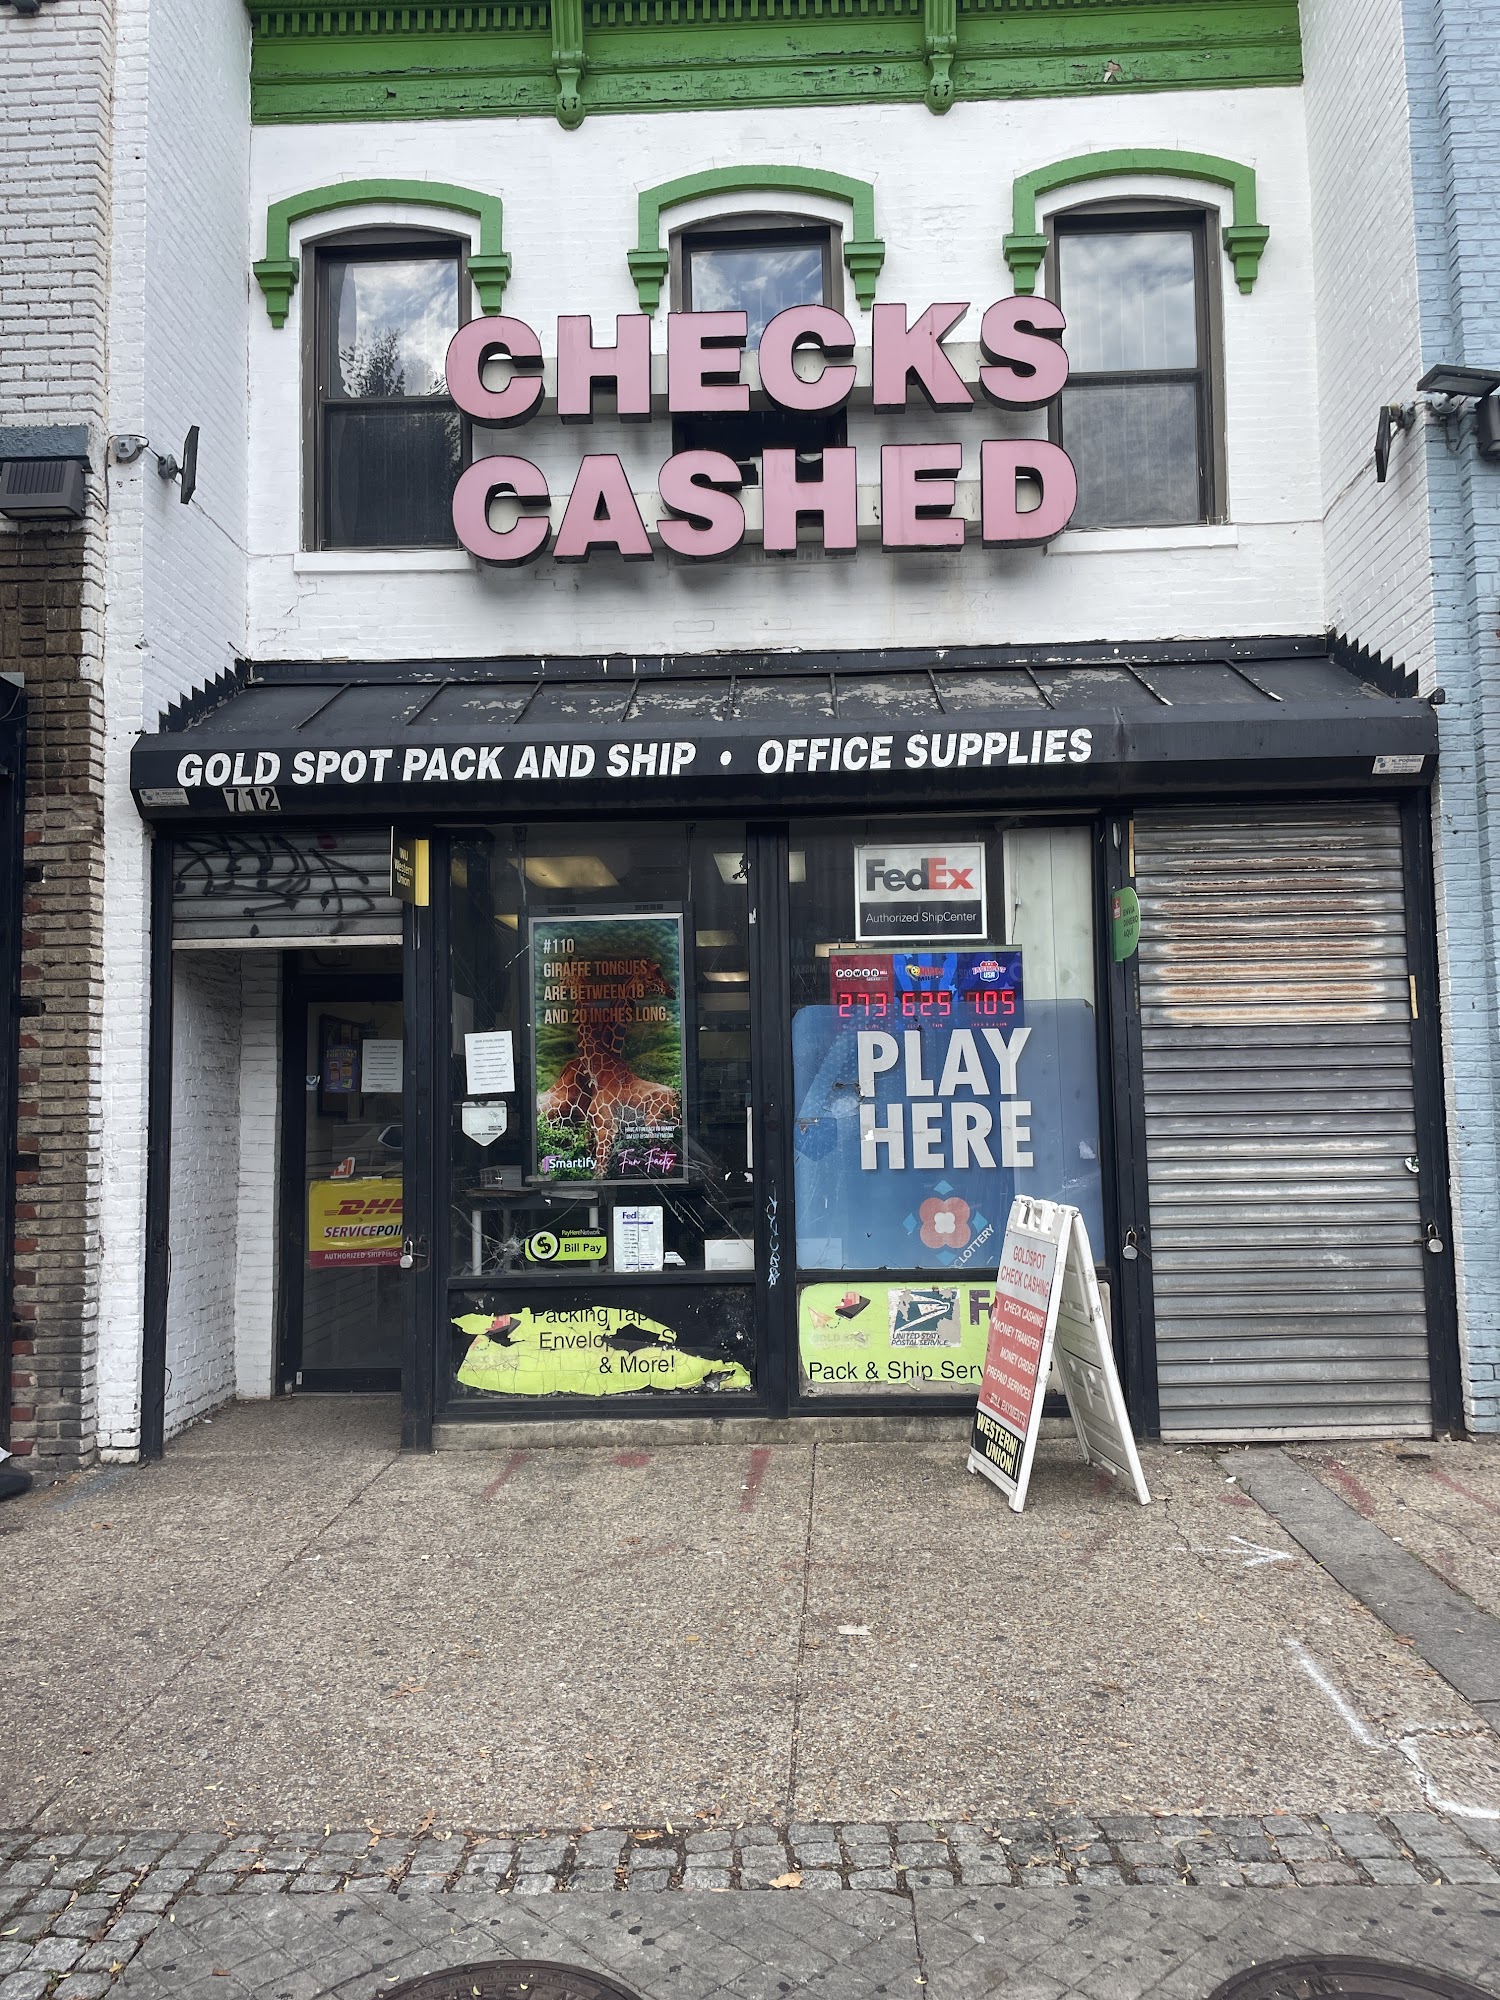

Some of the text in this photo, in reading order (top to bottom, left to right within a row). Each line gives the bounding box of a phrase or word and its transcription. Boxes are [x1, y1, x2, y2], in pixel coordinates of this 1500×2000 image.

[445, 295, 1069, 428] CHECKS
[452, 439, 1078, 568] CASHED
[177, 728, 1093, 787] GOLD SPOT PACK AND SHIP OFFICE SUPPLIES
[226, 787, 280, 812] 712
[394, 858, 414, 877] Western
[397, 872, 411, 887] Union
[866, 857, 974, 892] FedEx
[866, 911, 977, 923] Authorized ShipCenter
[543, 939, 575, 954] #110
[543, 960, 648, 977] GIRAFFE TONGUES
[983, 966, 996, 979] USA
[544, 983, 645, 1001] ARE BETWEEN 18
[544, 1006, 670, 1024] AND 20 INCHES LONG.
[838, 992, 887, 1018] 273
[902, 992, 951, 1017] 625
[857, 1028, 1033, 1097] PLAY
[860, 1101, 1034, 1170] HERE
[549, 1157, 598, 1170] Smartify
[618, 1147, 678, 1174] Fun Facts
[338, 1199, 403, 1215] DHL
[324, 1225, 403, 1238] SERVICEPOI
[324, 1250, 398, 1260] AUTHORIZED SHIPPING
[564, 1242, 602, 1254] Bill Pay
[1013, 1245, 1047, 1271] GOLDSPOT
[1000, 1265, 1050, 1298] CHECK CASHING
[533, 1309, 609, 1326] Packing
[1003, 1300, 1044, 1328] CHECK CASHING
[892, 1332, 920, 1340] UNITED
[993, 1320, 1040, 1352] MONEY TRANSFER
[599, 1355, 675, 1374] & More!
[808, 1361, 858, 1380] Pack
[865, 1361, 879, 1380] &
[887, 1360, 934, 1380] Ship
[999, 1346, 1018, 1365] MONEY
[1017, 1357, 1036, 1376] ORDER
[986, 1364, 1032, 1401] PREPAID SERVICES
[1001, 1400, 1027, 1426] PAYMENTS
[976, 1411, 1017, 1456] WESTERN
[985, 1439, 1013, 1475] UNION
